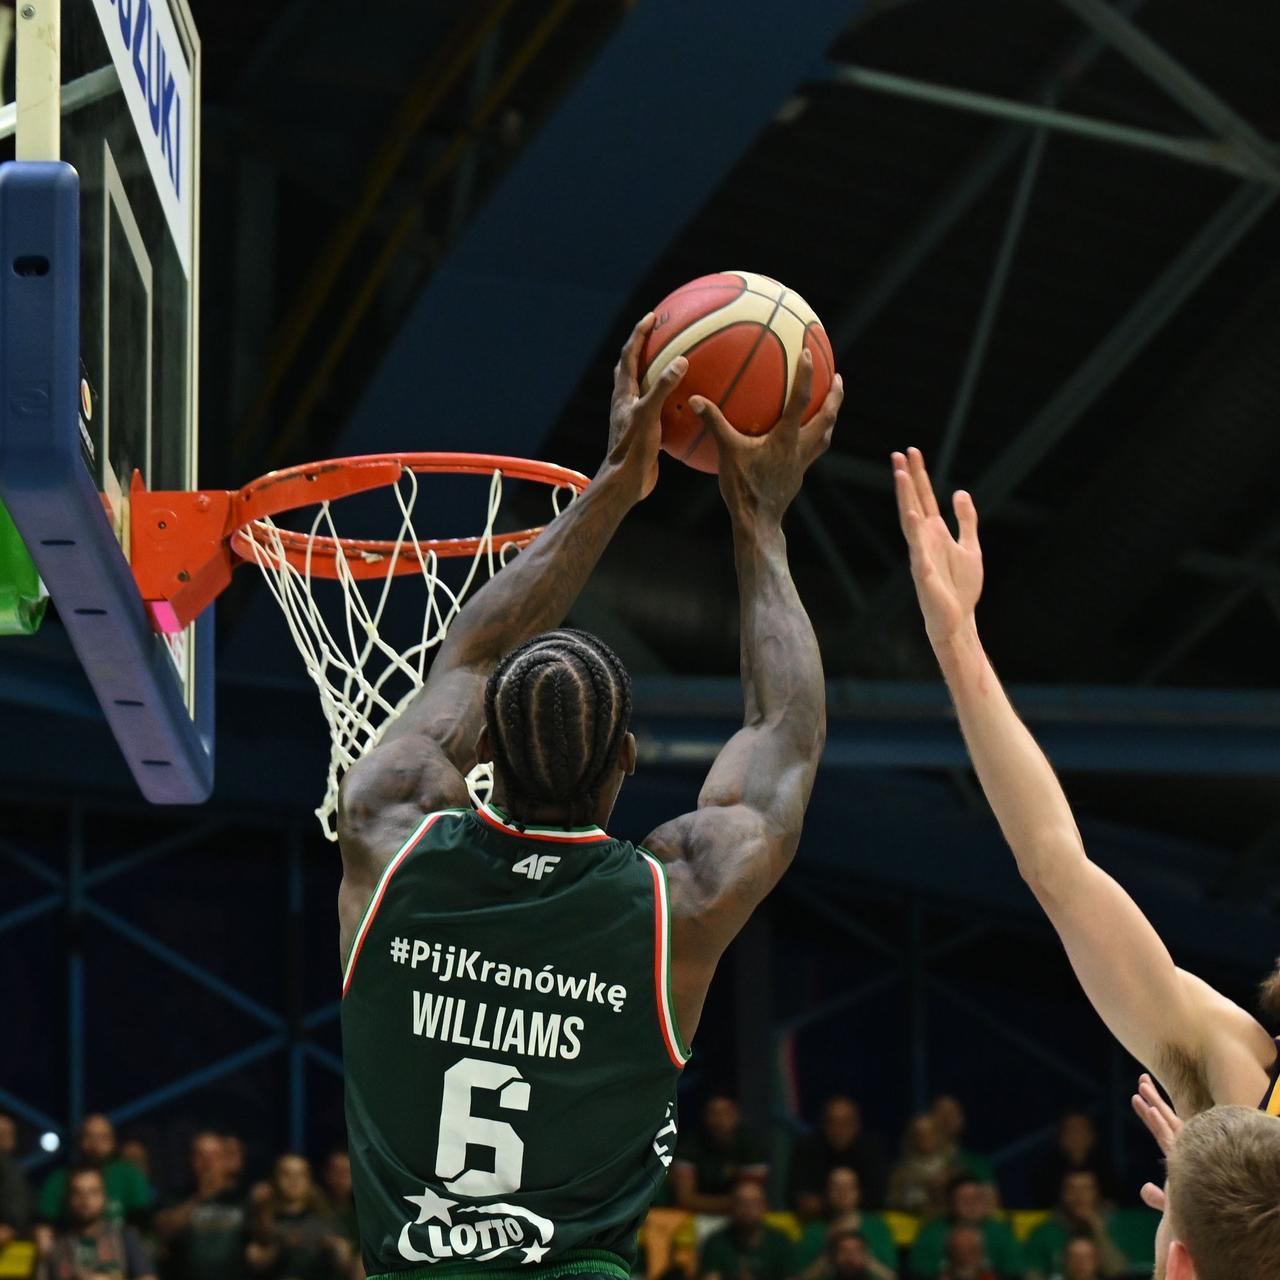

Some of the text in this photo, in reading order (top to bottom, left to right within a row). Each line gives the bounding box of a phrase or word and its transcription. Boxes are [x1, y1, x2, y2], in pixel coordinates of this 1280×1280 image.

[111, 0, 181, 202] UZUKI
[511, 854, 561, 880] 4F
[390, 937, 628, 1012] #PijKranówkę
[412, 990, 585, 1060] WILLIAMS
[435, 1057, 531, 1197] 6
[427, 1216, 524, 1259] LOTTO
